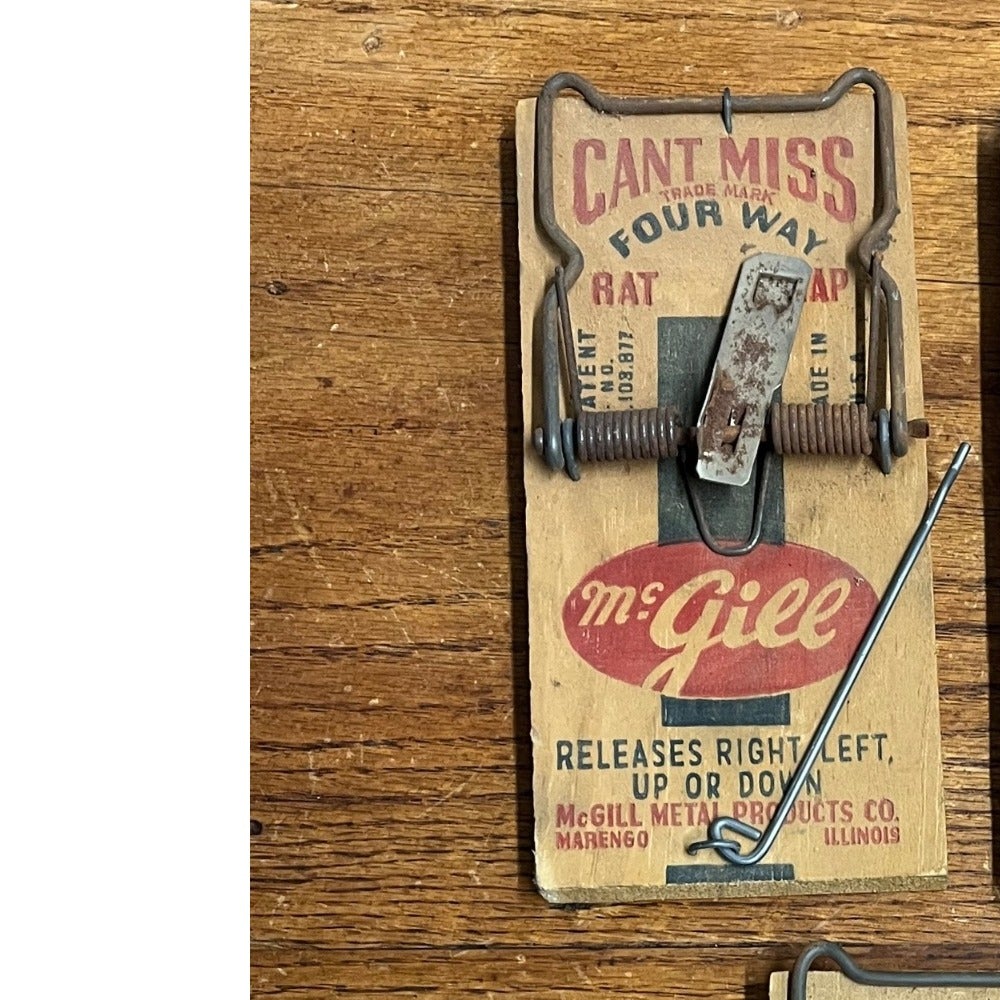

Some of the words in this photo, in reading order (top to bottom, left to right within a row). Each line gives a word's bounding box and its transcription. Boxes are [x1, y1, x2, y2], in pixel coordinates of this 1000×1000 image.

[573, 137, 703, 225] CANT
[720, 136, 857, 223] MISS
[659, 184, 717, 201] TRADE
[724, 185, 778, 205] MARK
[609, 200, 723, 259] FOUR
[742, 204, 827, 255] WAY
[591, 271, 659, 307] RAT
[811, 333, 828, 354] IN
[577, 328, 597, 409] ATENT
[810, 366, 829, 404] ADE
[578, 569, 852, 696] McGill
[556, 739, 702, 770] RELEASES
[821, 733, 893, 766] LEFT,
[632, 772, 668, 800] UP
[685, 772, 721, 799] OR
[556, 803, 643, 828] McGILL
[864, 798, 900, 823] CO.
[556, 831, 649, 850] MARENGO
[824, 826, 900, 846] ILLINOIS
